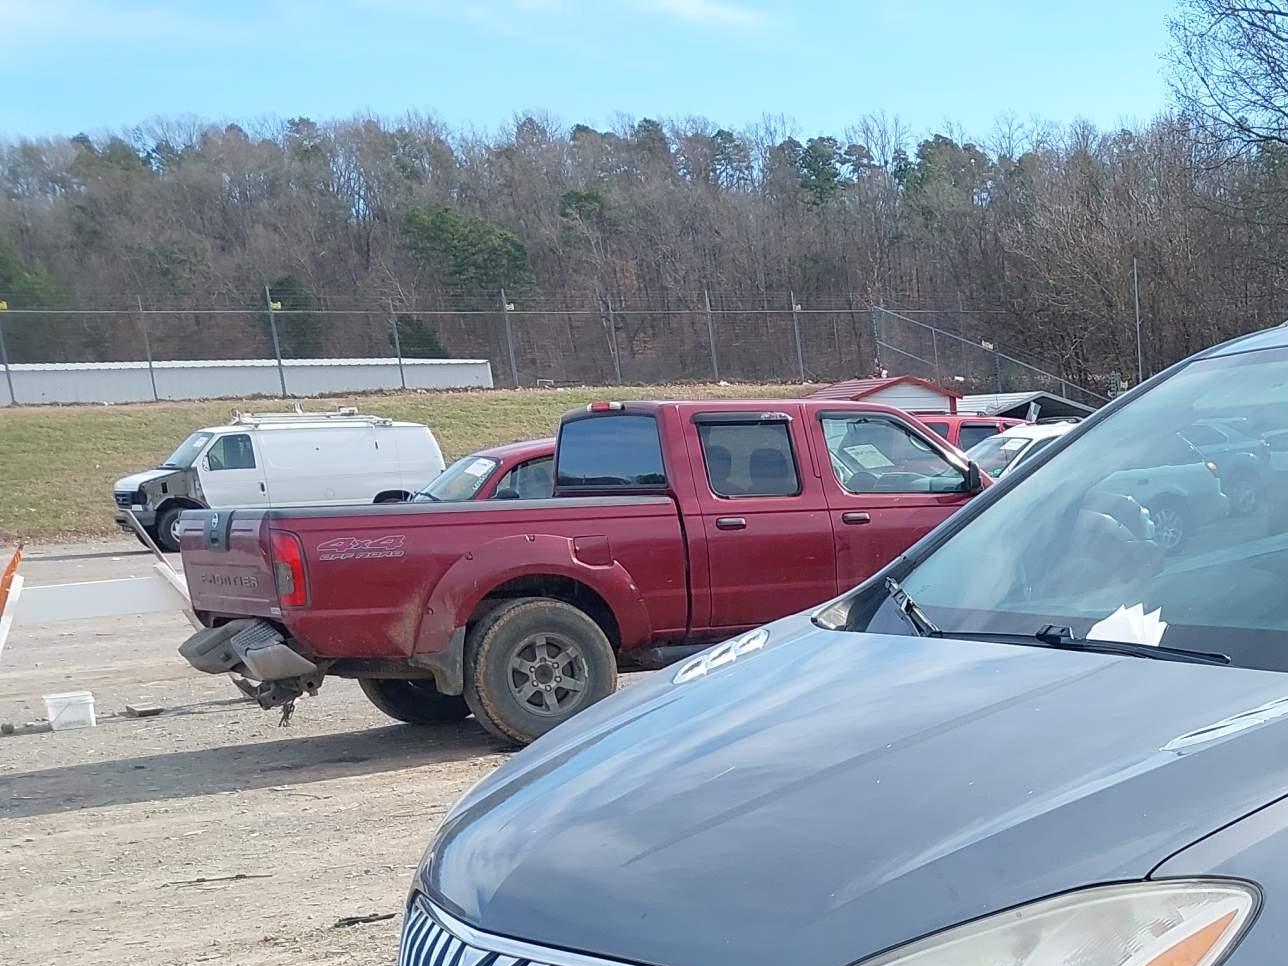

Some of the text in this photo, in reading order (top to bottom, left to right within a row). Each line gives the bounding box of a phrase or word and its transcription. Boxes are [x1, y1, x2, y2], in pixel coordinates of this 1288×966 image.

[319, 550, 405, 561] OFF ROAD
[201, 574, 258, 588] FRONTIER
